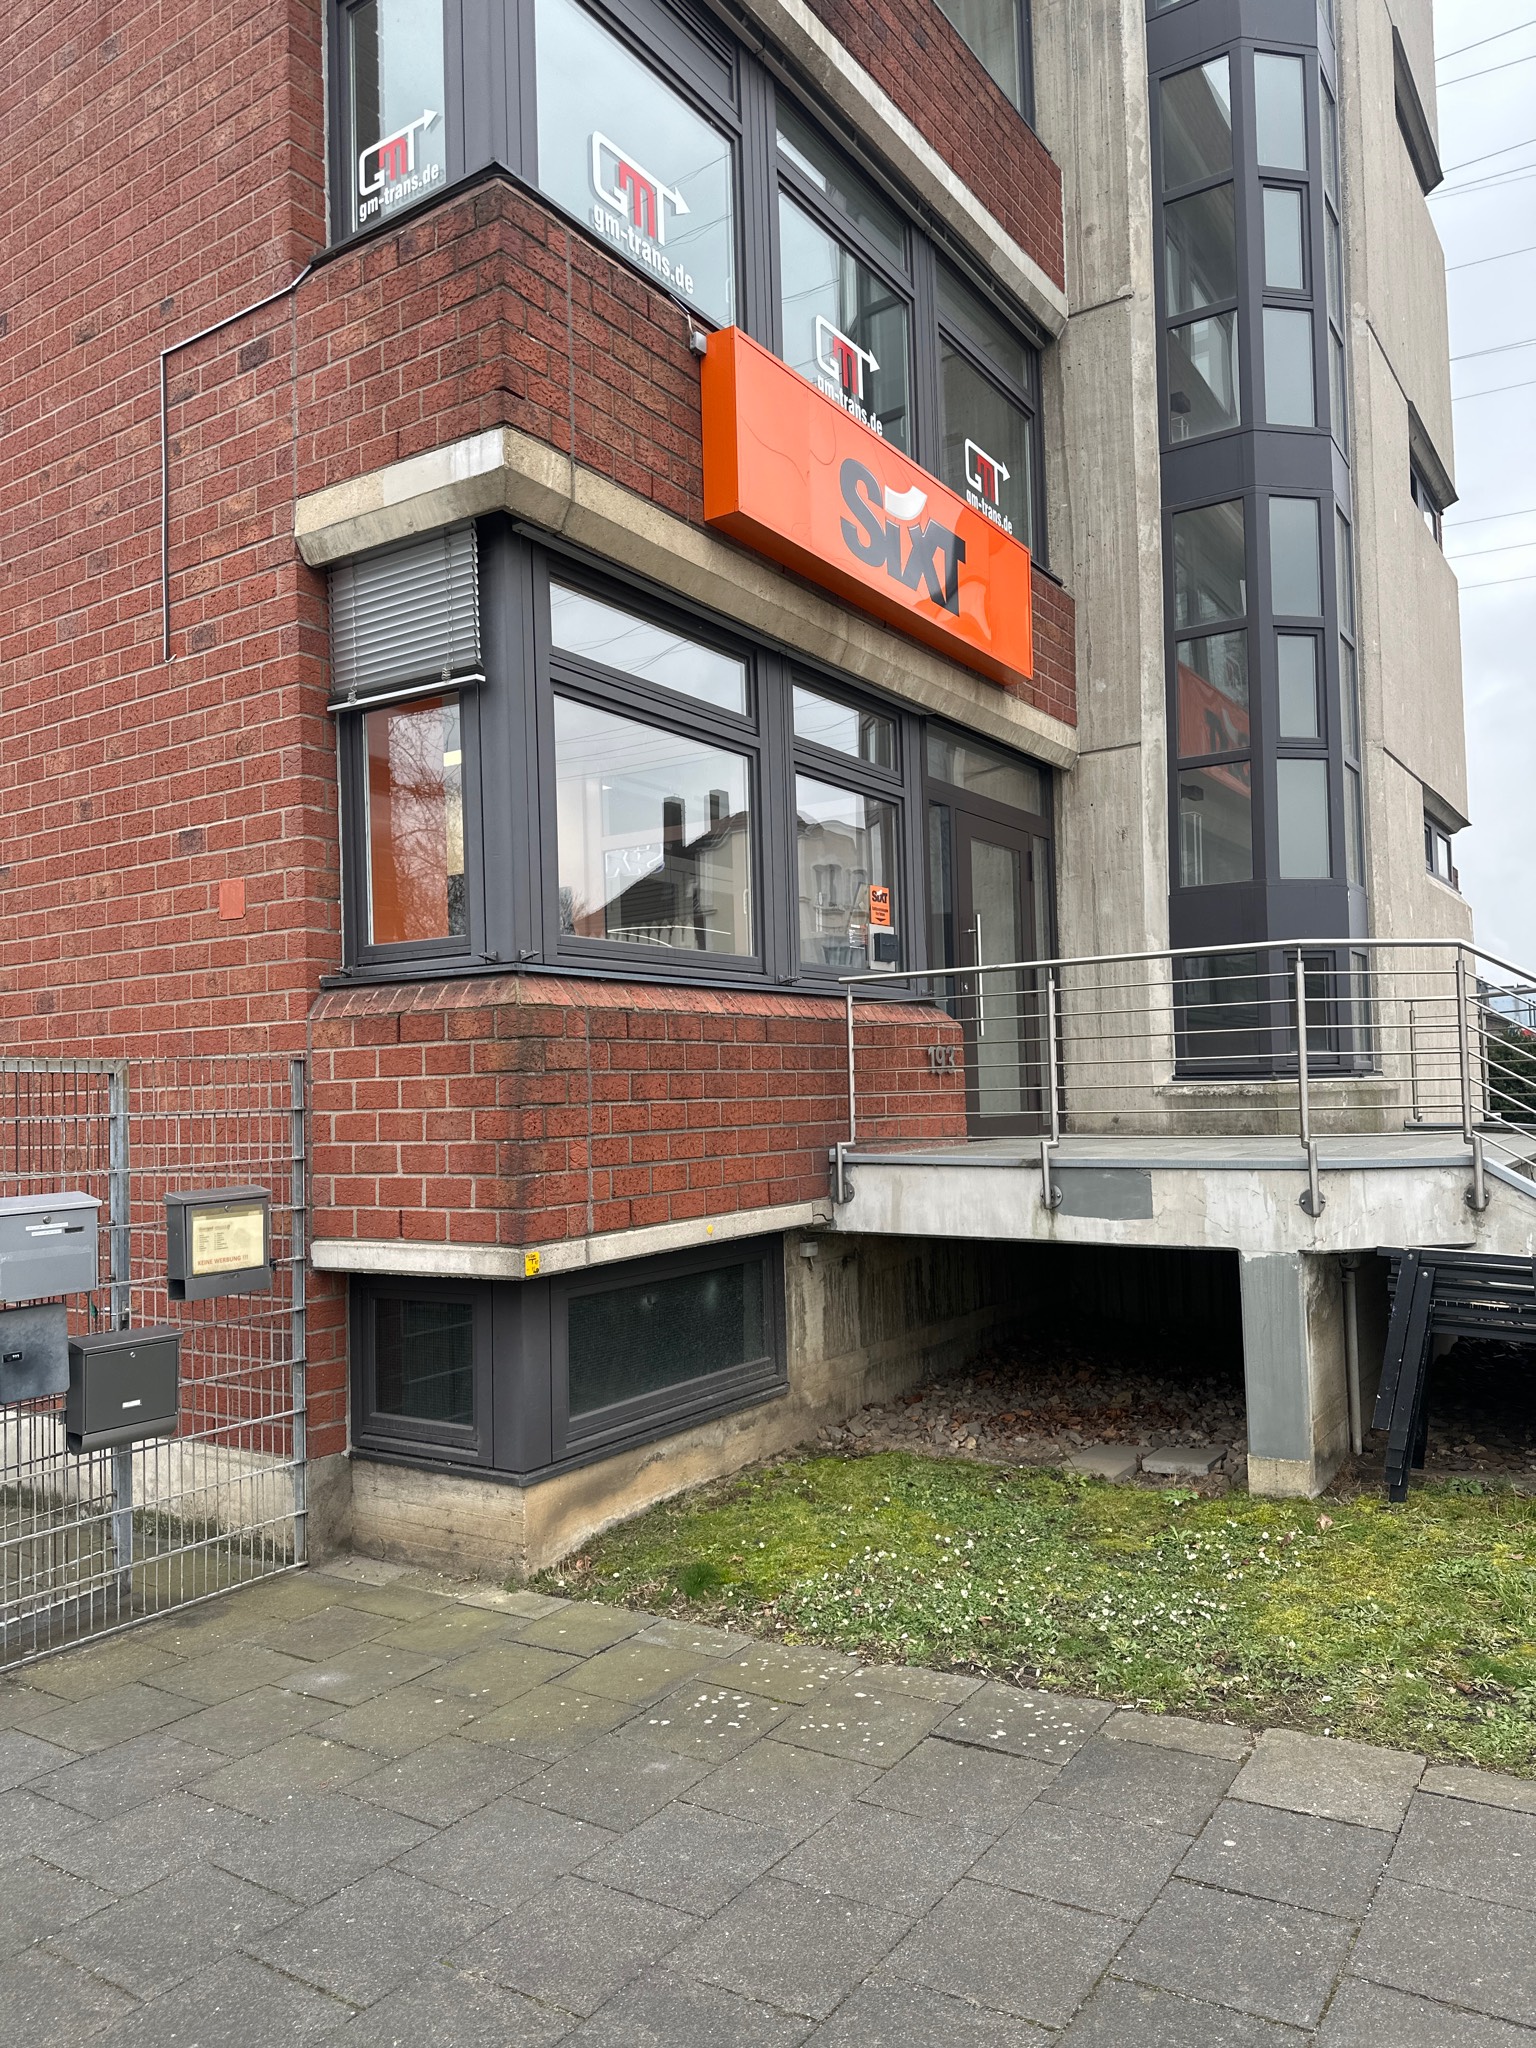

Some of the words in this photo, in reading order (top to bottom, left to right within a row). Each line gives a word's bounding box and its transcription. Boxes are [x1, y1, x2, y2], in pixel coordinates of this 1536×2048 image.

[359, 164, 439, 222] gm-trans.de
[593, 204, 694, 294] gm-trans.de
[928, 1045, 955, 1074] 193
[198, 1258, 213, 1266] KEINE
[214, 1255, 241, 1264] WERBUNG
